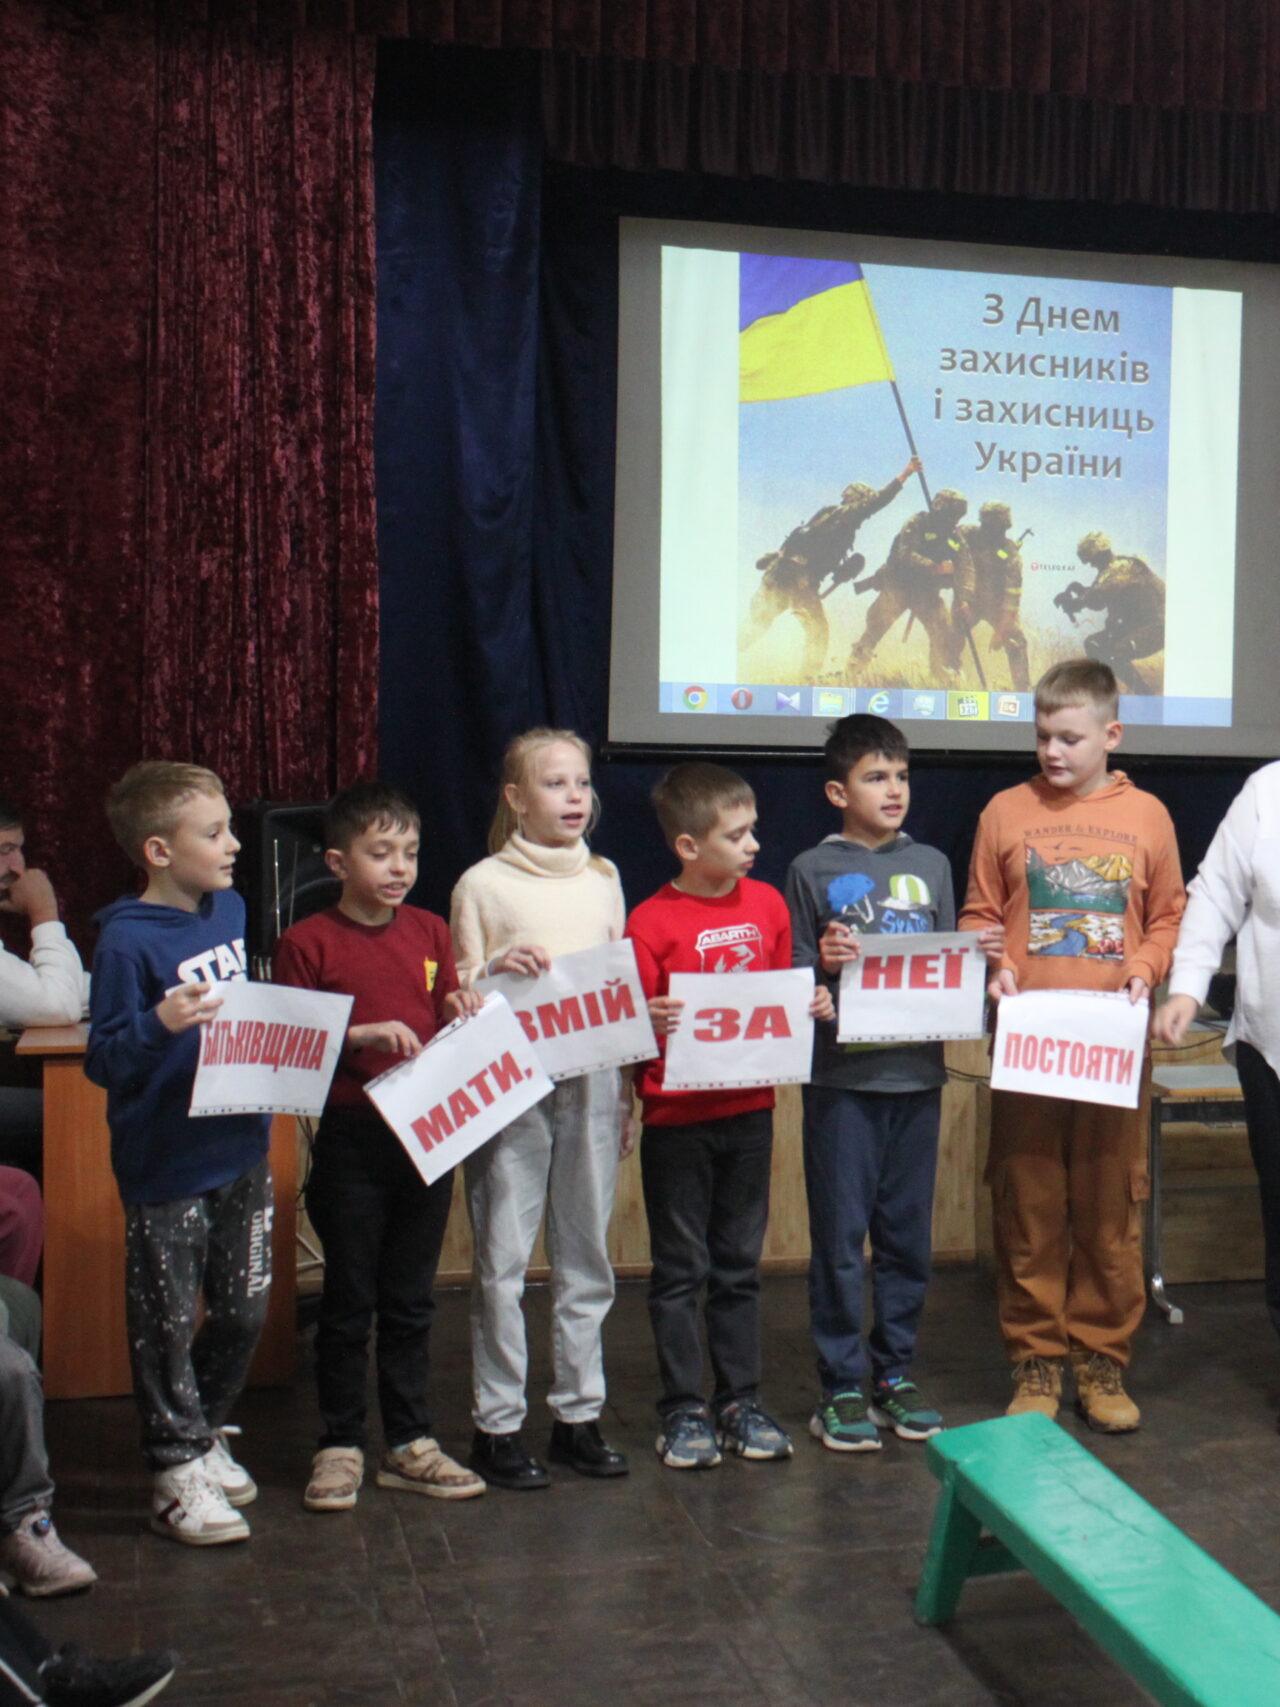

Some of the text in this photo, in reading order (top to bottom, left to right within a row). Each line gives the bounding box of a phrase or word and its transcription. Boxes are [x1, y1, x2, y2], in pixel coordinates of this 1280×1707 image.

[982, 293, 1120, 337] З Днем
[939, 347, 1150, 384] захисників
[934, 387, 1155, 440] і захисниць
[974, 440, 1122, 483] України
[702, 928, 758, 945] ABARTH
[861, 947, 970, 990] НЕЇ
[693, 1005, 792, 1043] ЗА
[203, 1020, 328, 1073] БАТЬКІВЩИНА
[1003, 1032, 1135, 1086] ПОСТОЯТИ
[410, 1051, 533, 1153] МАТИ,
[247, 1210, 265, 1297] ORIGINAL
